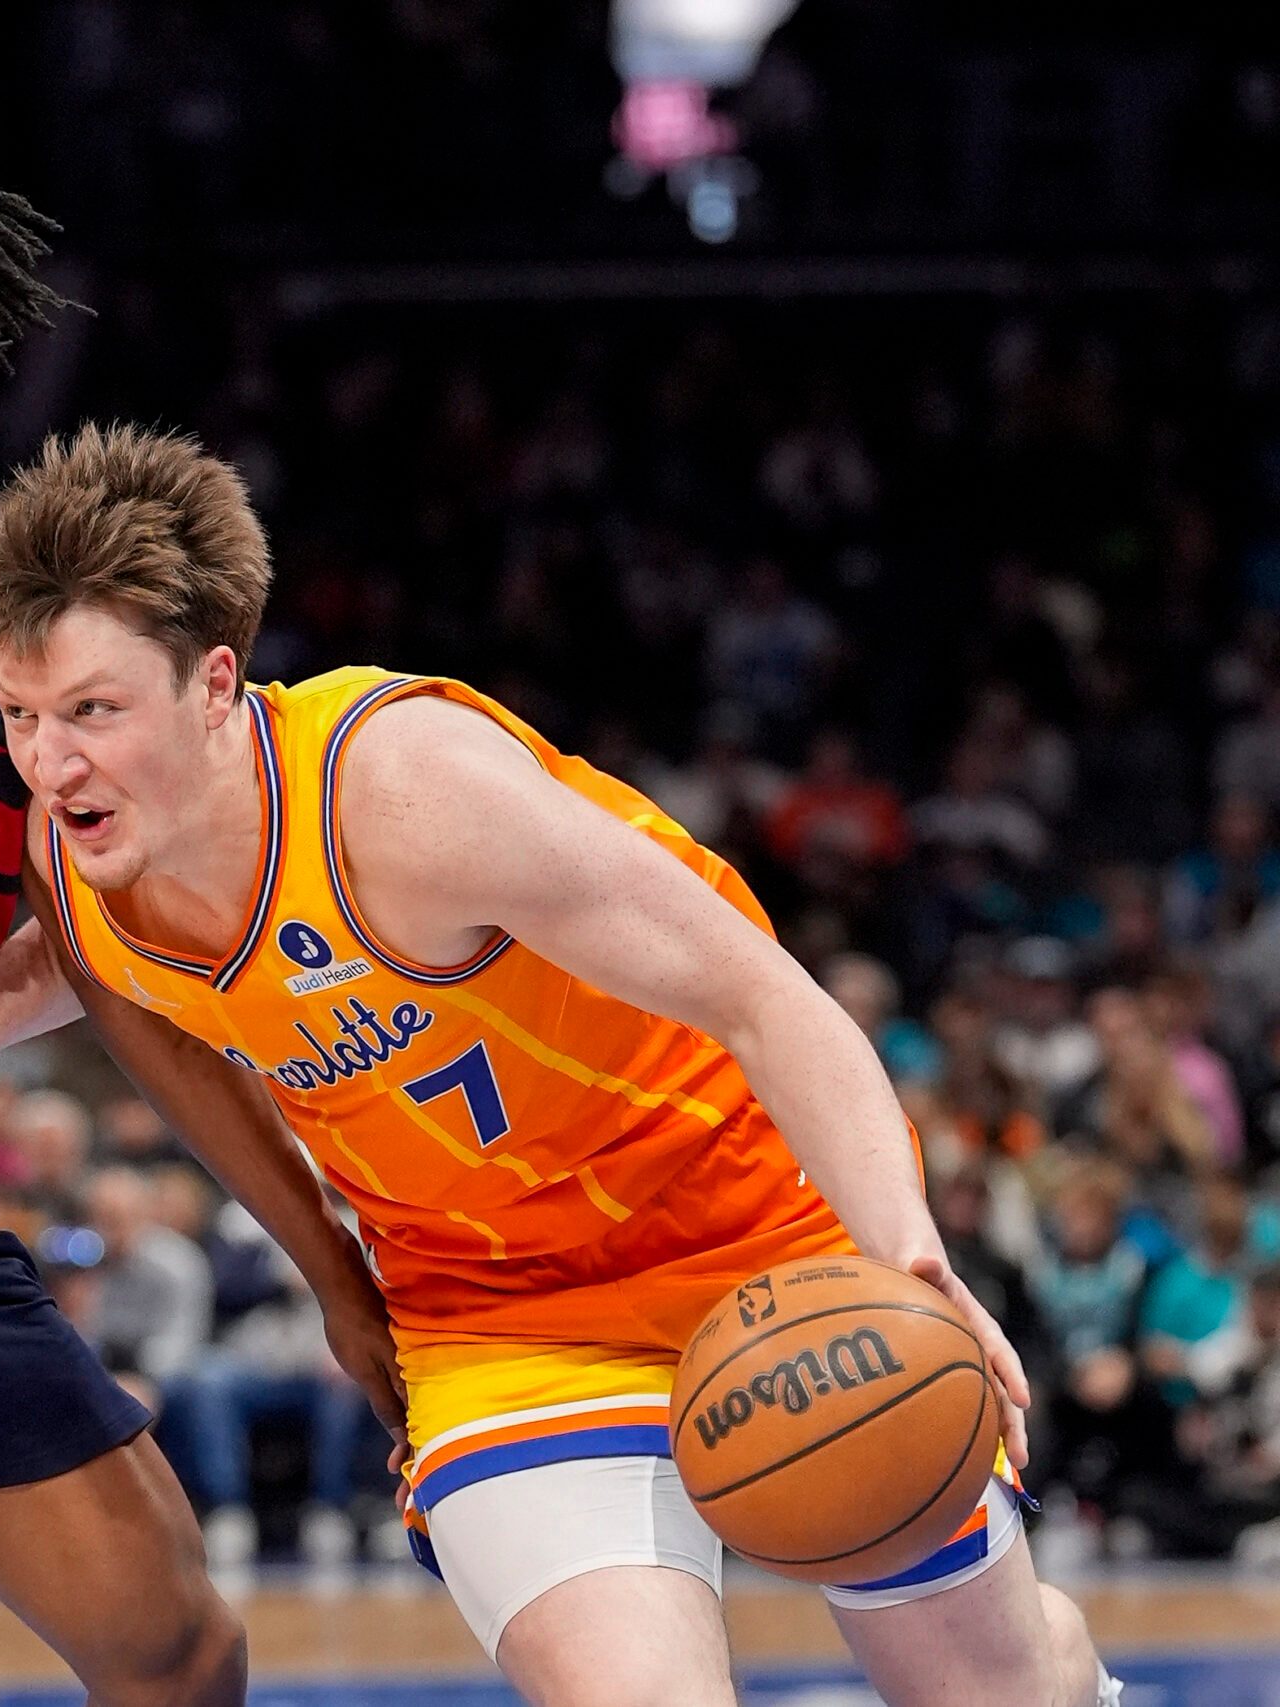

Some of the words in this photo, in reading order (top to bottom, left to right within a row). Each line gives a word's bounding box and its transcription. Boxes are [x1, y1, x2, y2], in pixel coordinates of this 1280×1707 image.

[293, 974, 325, 993] Judi
[321, 962, 371, 985] Health
[401, 1038, 512, 1150] 7
[693, 1326, 907, 1451] Wilson
